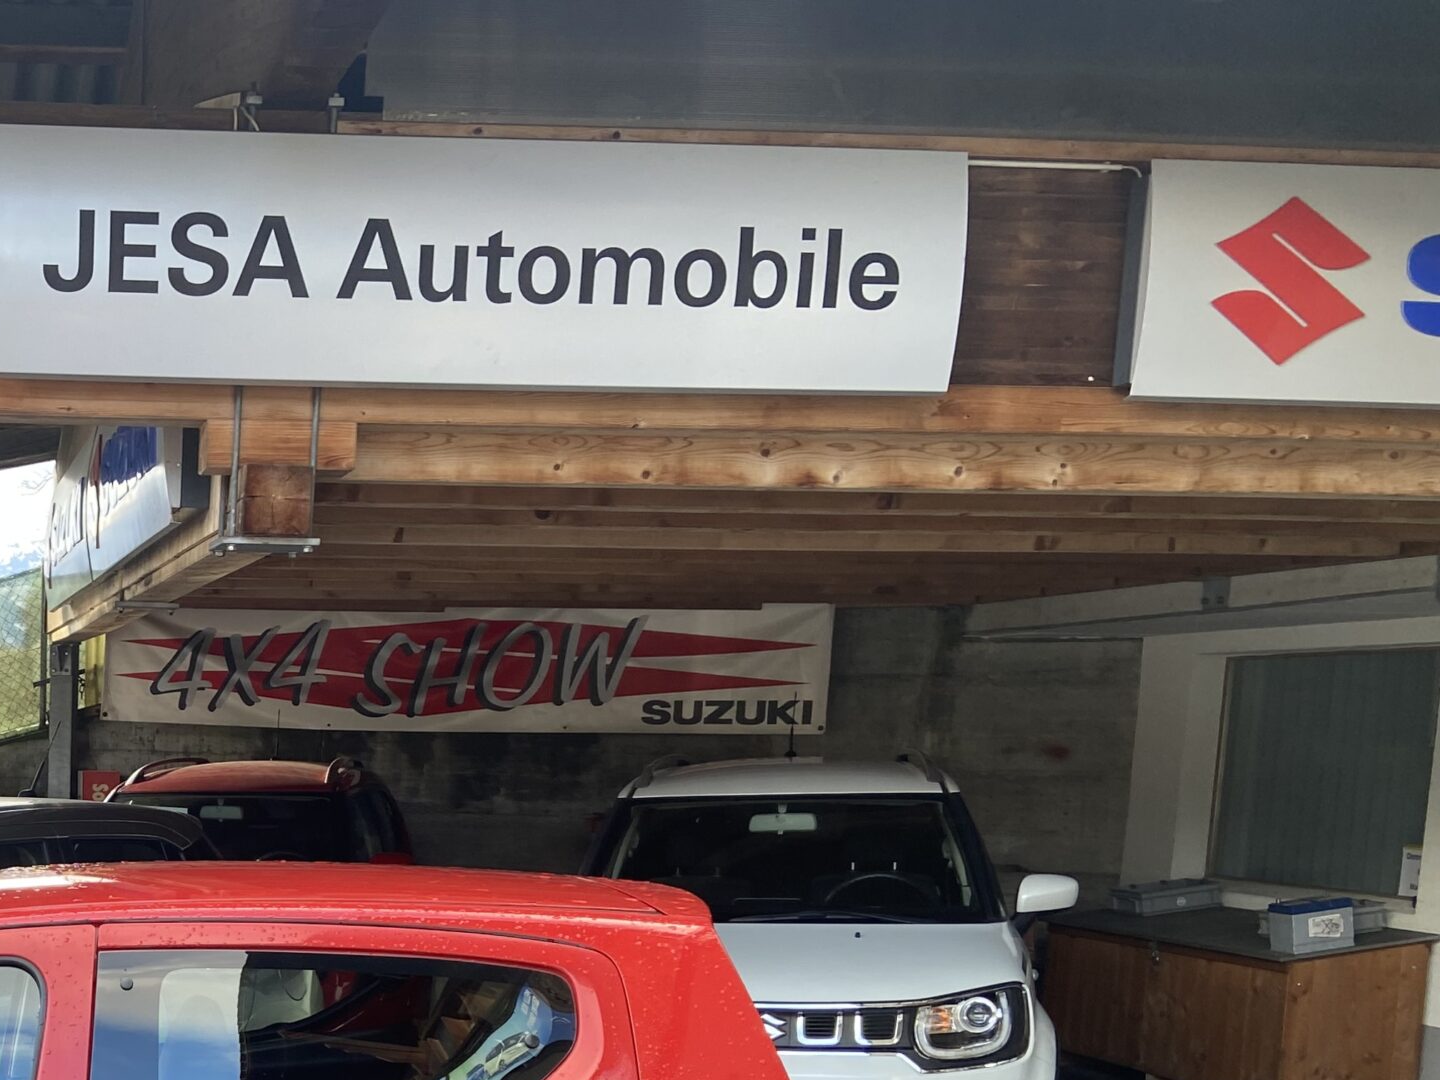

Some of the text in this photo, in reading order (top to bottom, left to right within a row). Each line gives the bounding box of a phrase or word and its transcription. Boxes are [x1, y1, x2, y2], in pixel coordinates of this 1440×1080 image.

[42, 209, 900, 311] JESA Automobile
[150, 615, 648, 717] 4X4 SHOW
[641, 699, 813, 726] SUZUKI
